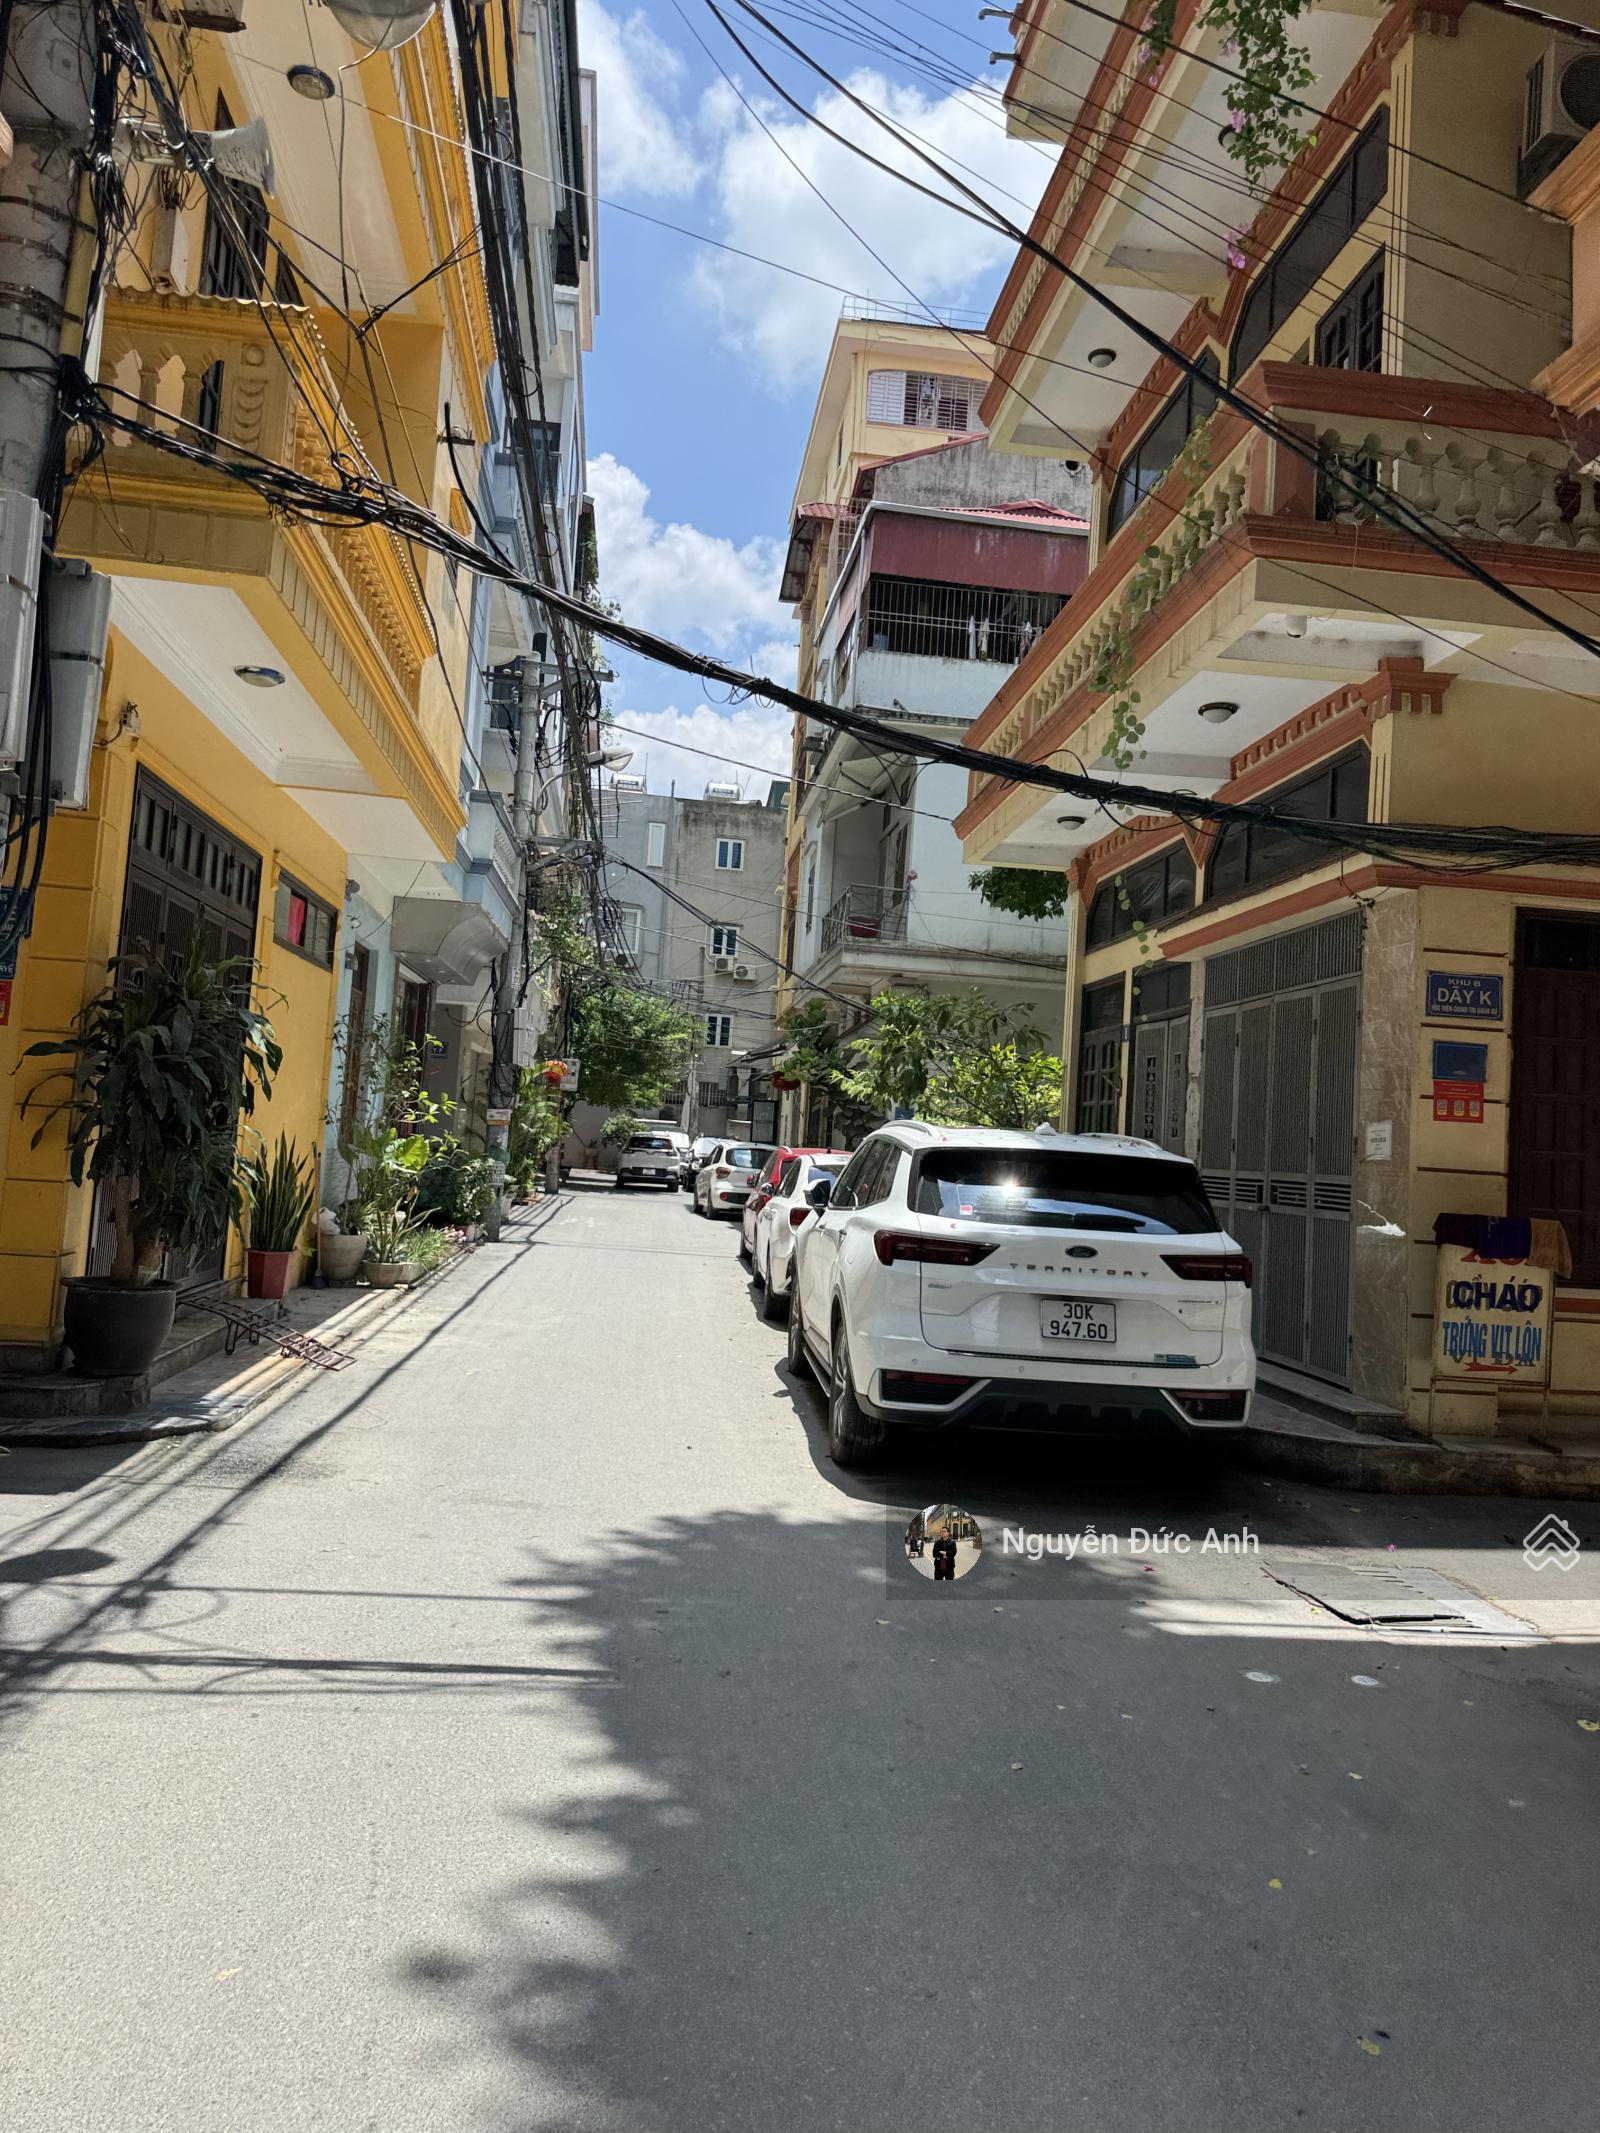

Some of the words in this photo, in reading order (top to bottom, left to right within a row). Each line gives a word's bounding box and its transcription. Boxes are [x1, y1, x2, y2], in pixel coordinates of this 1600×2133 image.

[1448, 978, 1471, 987] KHU
[1473, 980, 1481, 988] B
[1437, 985, 1475, 1004] DÃY
[1479, 990, 1492, 1006] K
[1009, 1263, 1149, 1277] TERRITORY
[1063, 1303, 1094, 1321] 30K
[1050, 1320, 1108, 1340] 947.60
